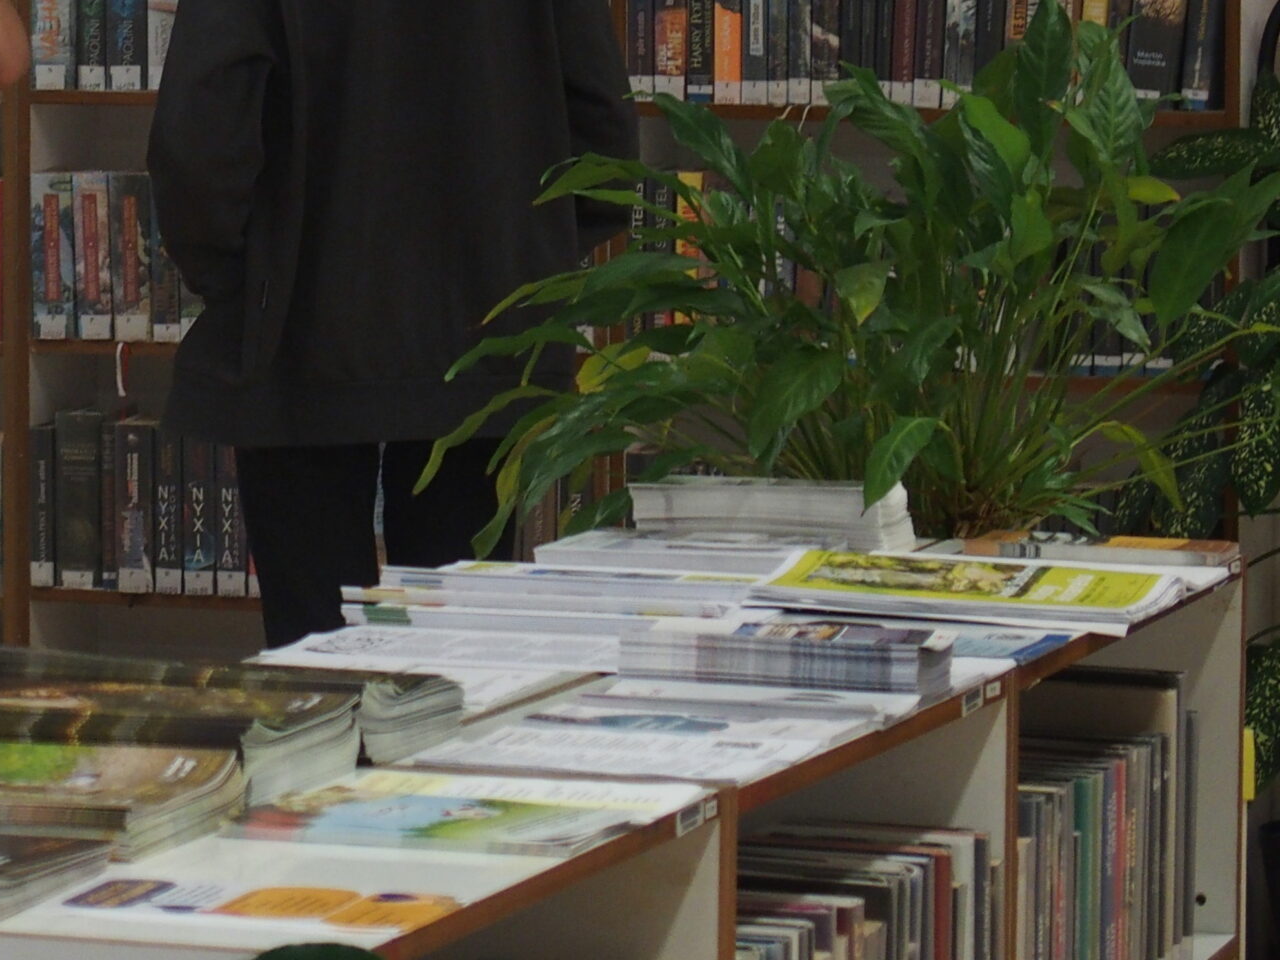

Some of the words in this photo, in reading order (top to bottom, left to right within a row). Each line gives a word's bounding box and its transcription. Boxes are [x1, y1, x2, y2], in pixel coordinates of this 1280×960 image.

[88, 20, 100, 67] PAOLINI
[123, 20, 134, 66] PAOLINI
[691, 28, 701, 68] HARRY
[157, 484, 170, 562] NYXIA
